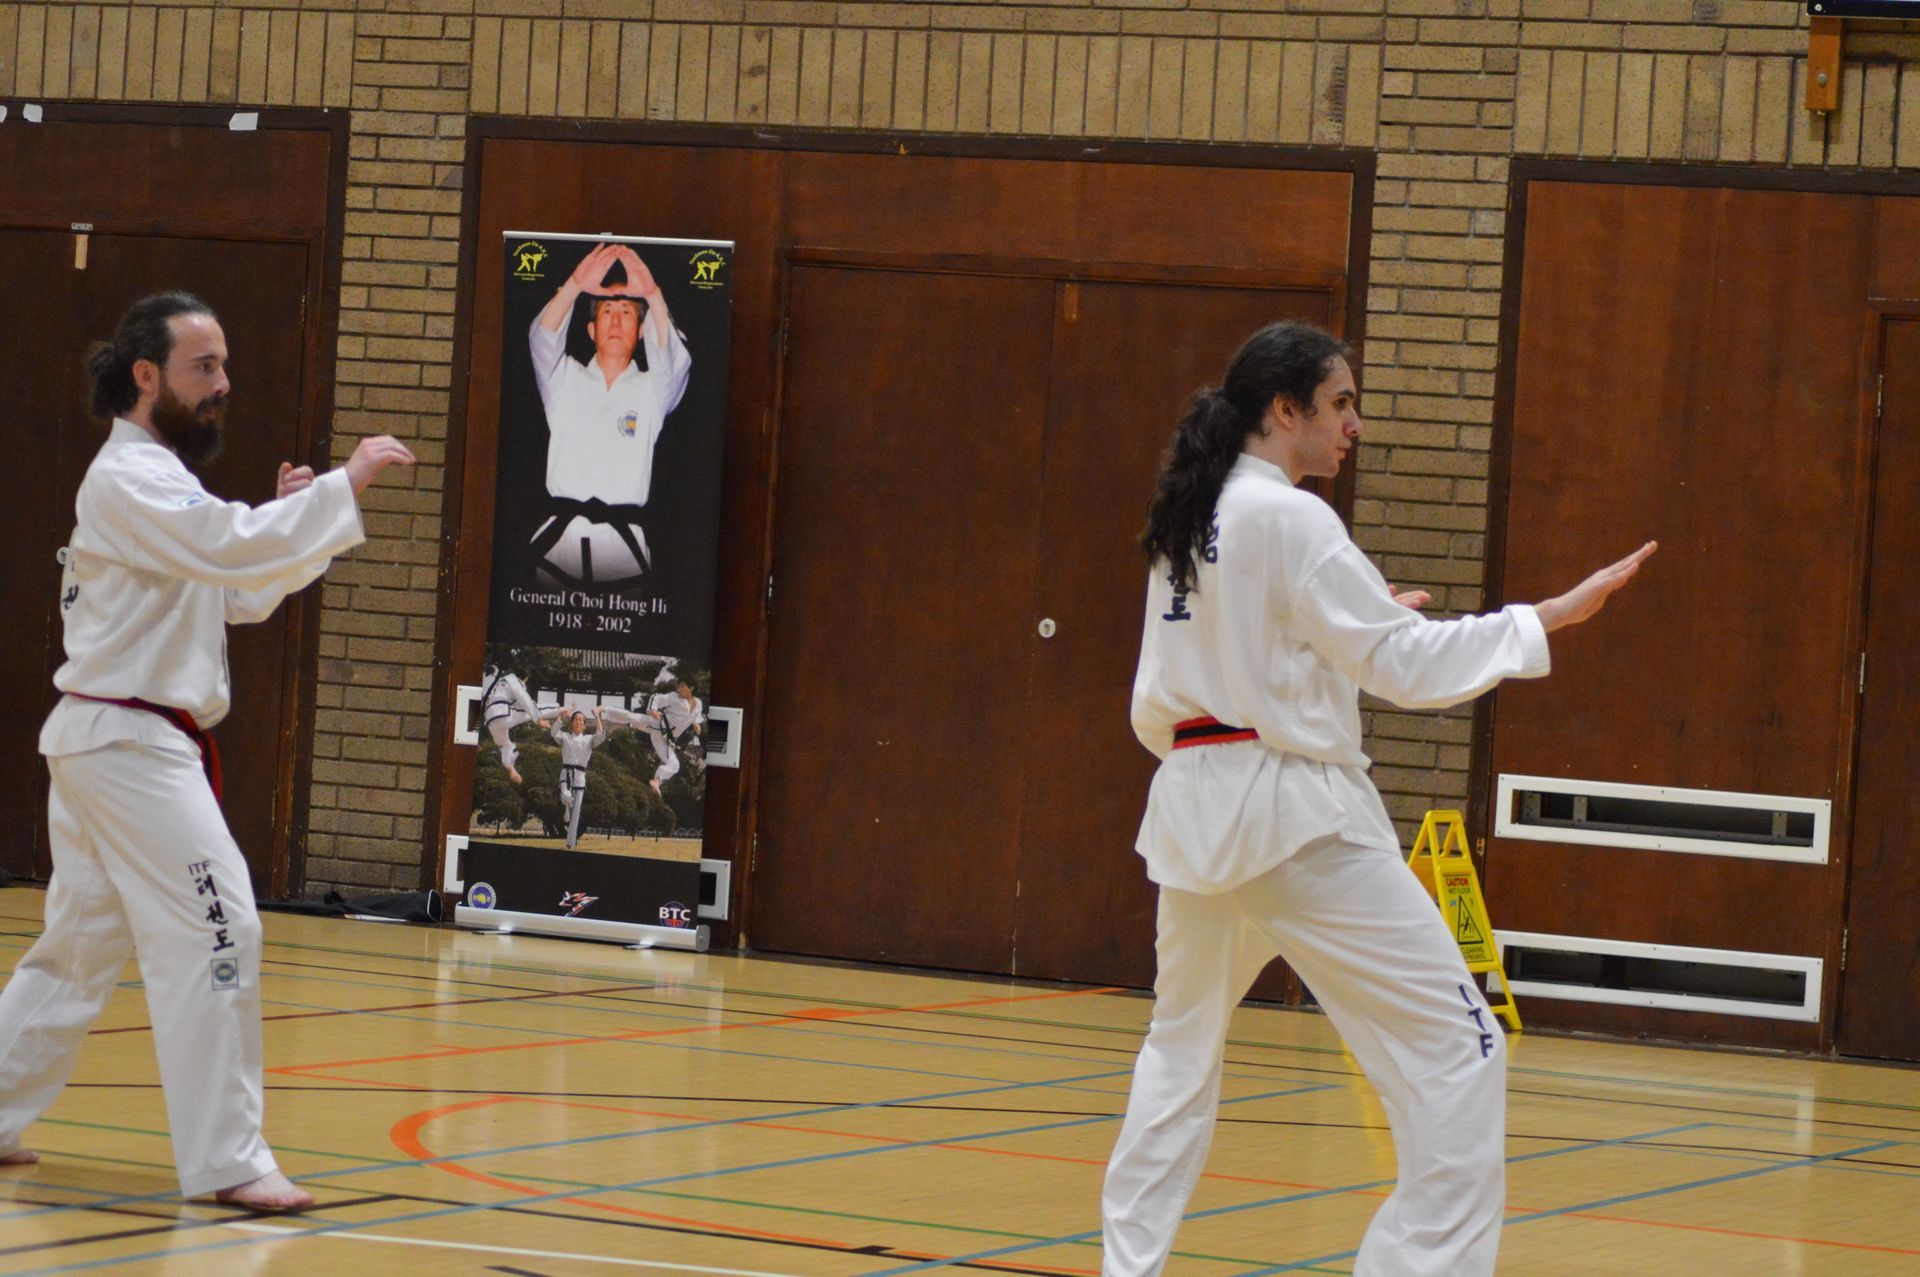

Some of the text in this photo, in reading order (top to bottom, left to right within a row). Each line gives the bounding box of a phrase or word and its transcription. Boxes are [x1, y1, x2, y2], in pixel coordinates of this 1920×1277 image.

[510, 587, 566, 606] General
[570, 591, 604, 609] Choi
[608, 594, 648, 616] Hong
[549, 611, 583, 629] 1918
[596, 615, 632, 633] 2002
[187, 859, 211, 876] ITF
[658, 905, 692, 922] BTC
[1458, 983, 1494, 1058] ITF
